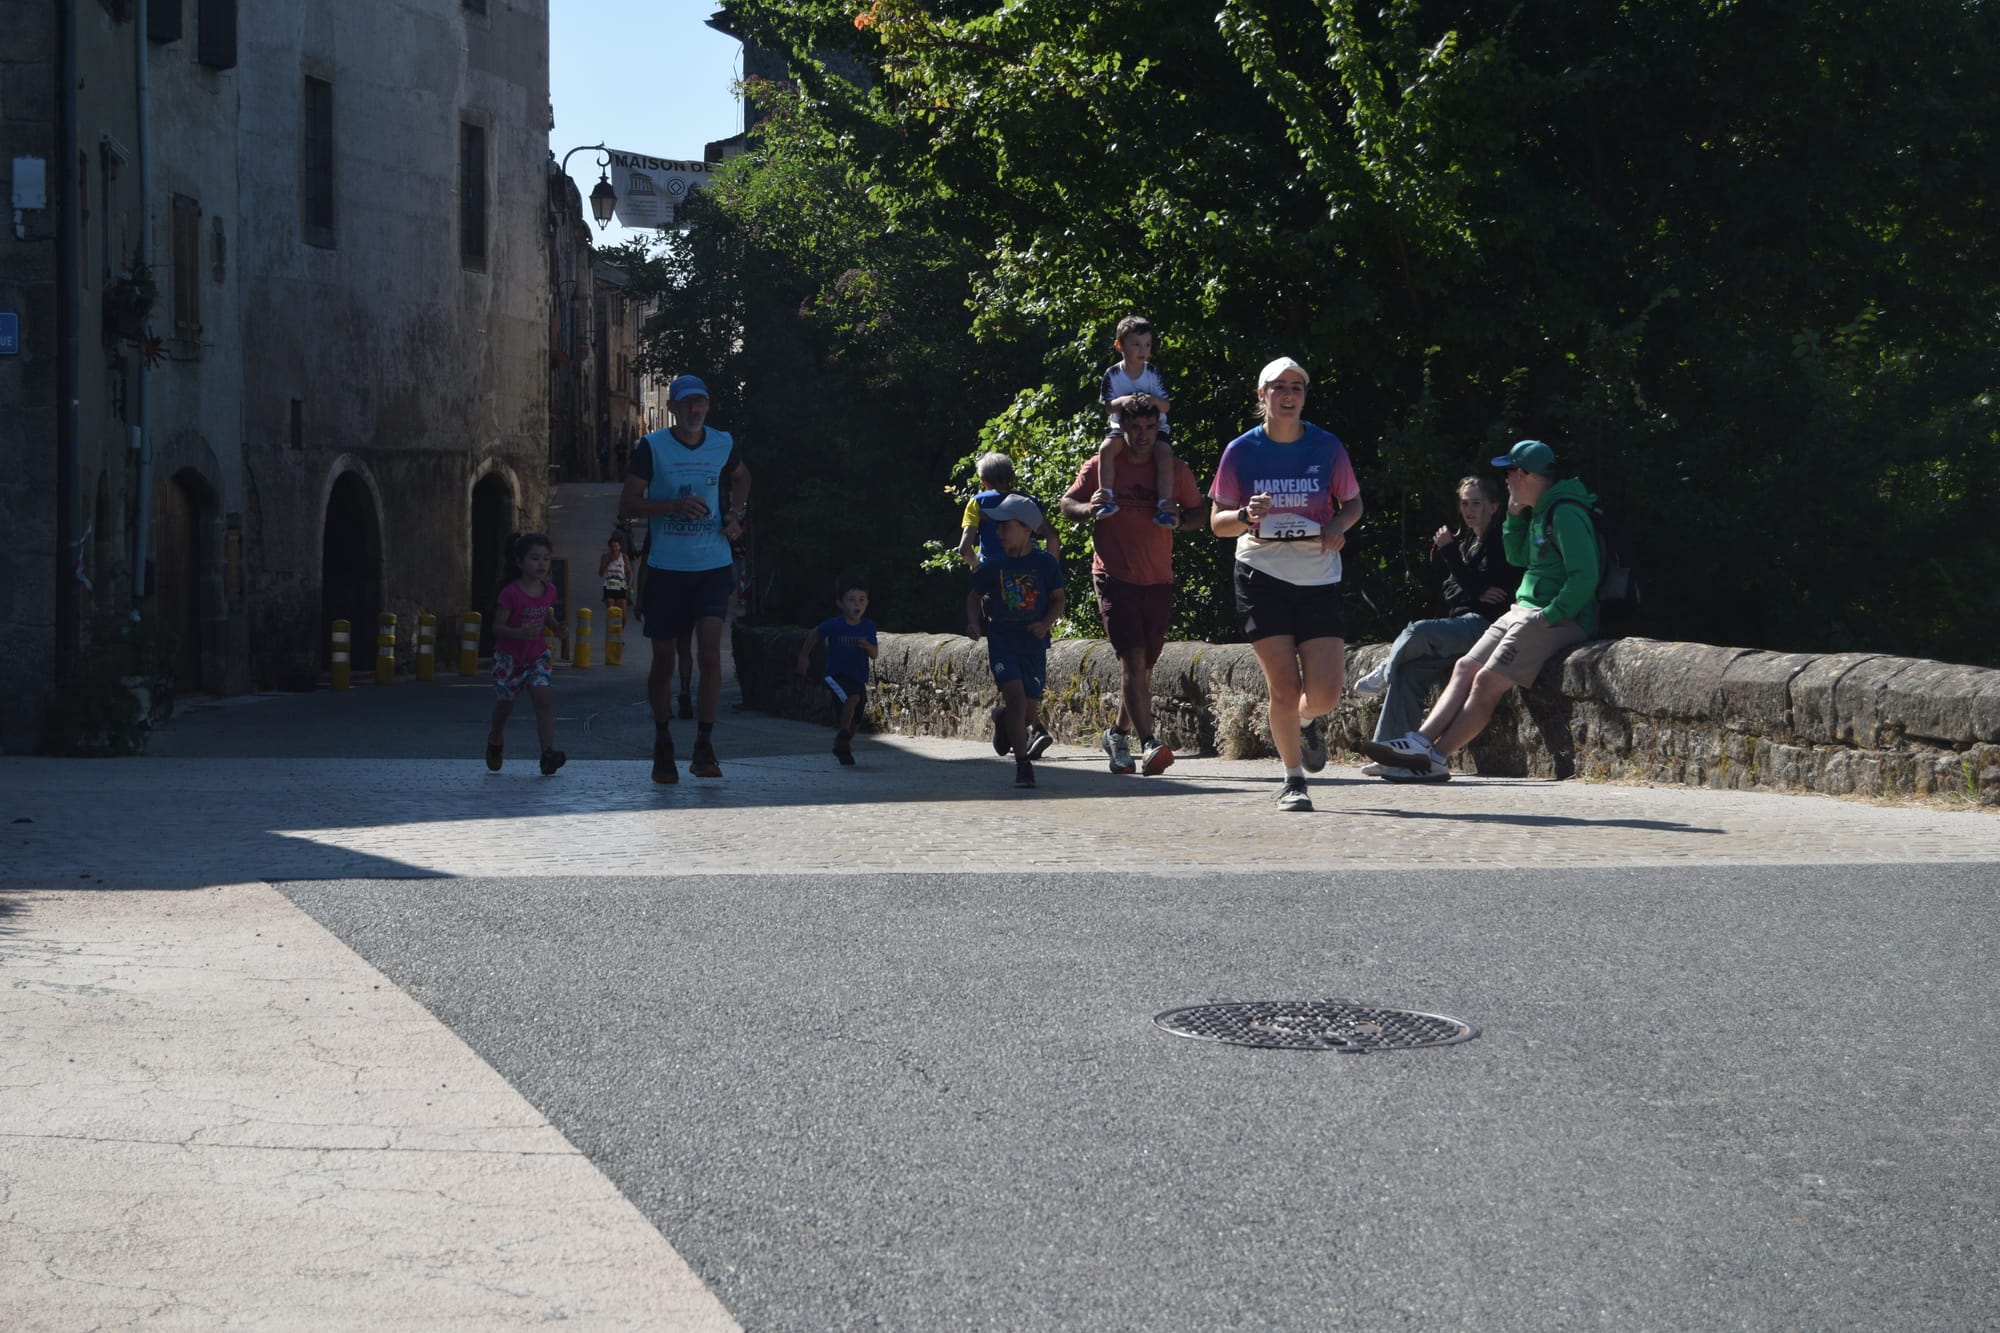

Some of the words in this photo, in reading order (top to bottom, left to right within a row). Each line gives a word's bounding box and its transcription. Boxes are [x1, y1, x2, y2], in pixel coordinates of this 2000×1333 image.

[615, 154, 685, 172] MAISON
[691, 163, 714, 173] DE
[1253, 478, 1320, 494] MARVEJOLS
